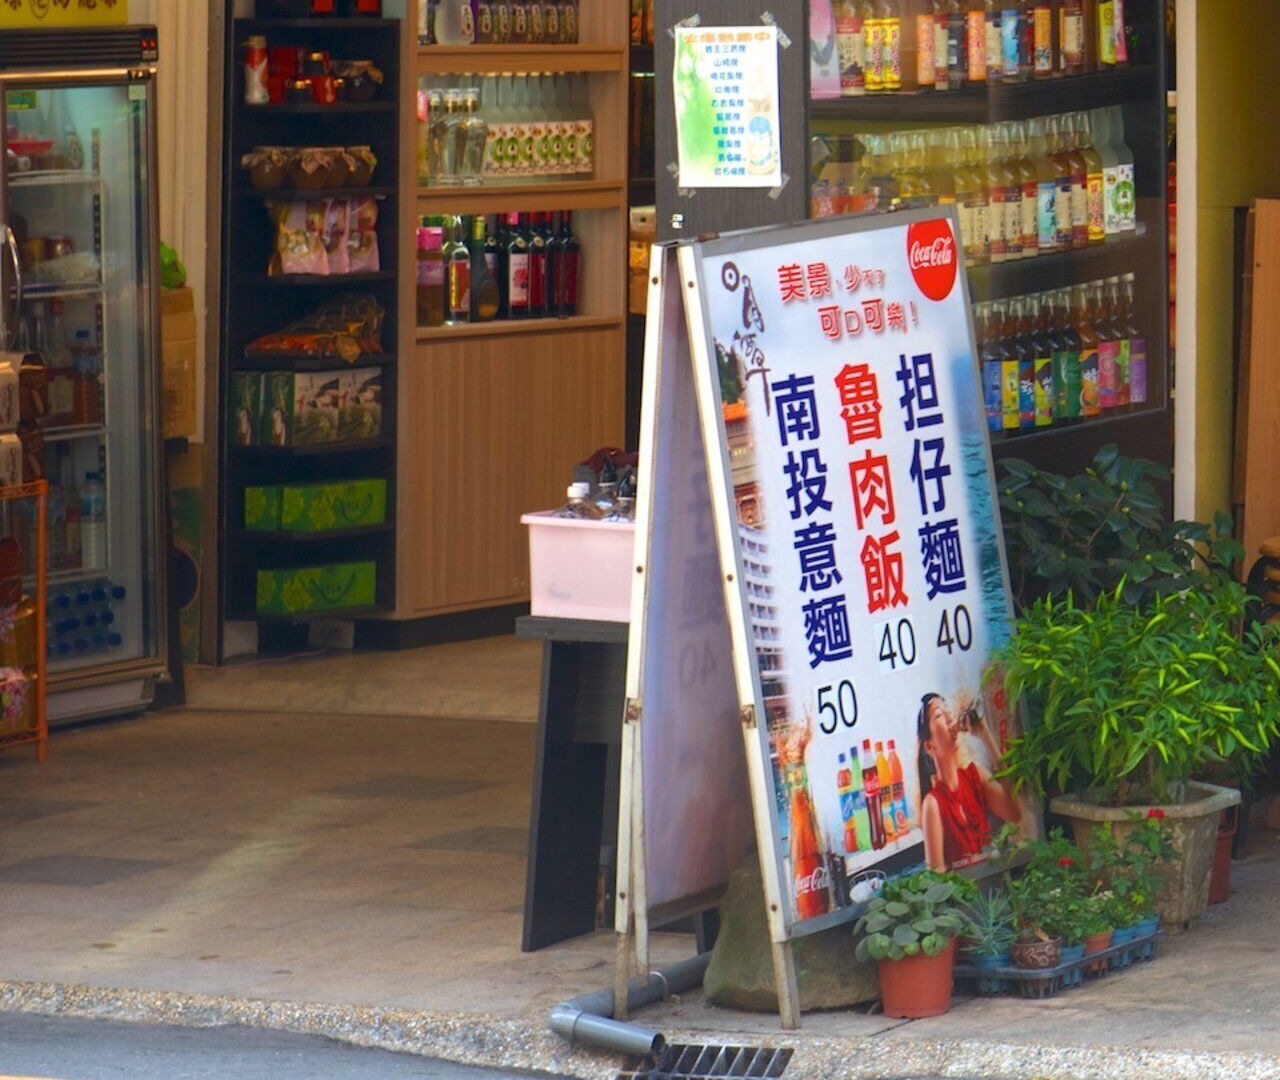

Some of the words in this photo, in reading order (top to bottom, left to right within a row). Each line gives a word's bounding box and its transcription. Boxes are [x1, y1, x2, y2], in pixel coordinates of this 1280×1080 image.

[910, 236, 954, 271] Coca-Cola
[833, 362, 909, 615] 魯肉飯
[896, 352, 967, 601] 担仔麵
[771, 373, 855, 669] 南投意麵
[878, 617, 918, 670] 40
[936, 604, 973, 656] 40
[817, 679, 860, 735] 50
